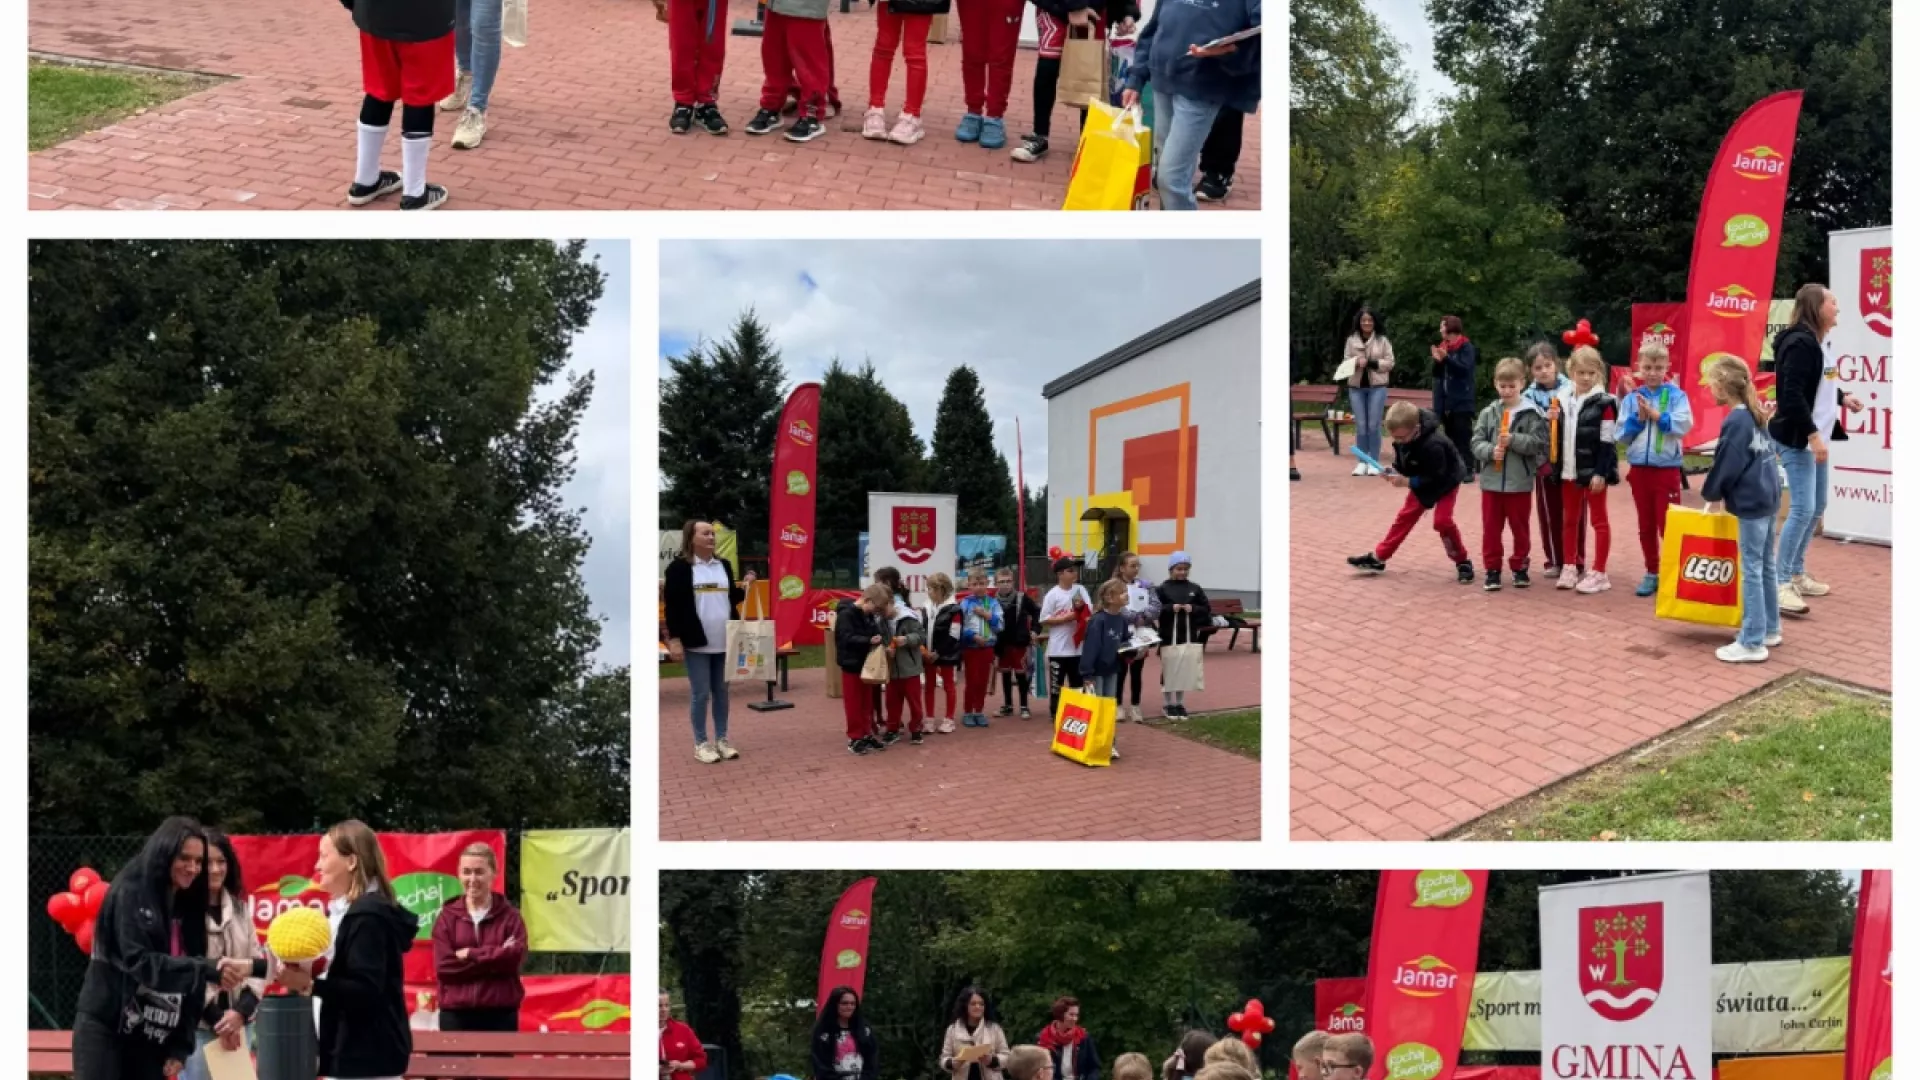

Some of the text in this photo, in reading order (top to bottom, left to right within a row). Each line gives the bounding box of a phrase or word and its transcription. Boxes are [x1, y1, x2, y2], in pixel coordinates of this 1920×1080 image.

[1732, 154, 1785, 176] Jamar
[1705, 291, 1758, 311] Jamar
[1684, 556, 1735, 583] LEGO
[1062, 718, 1088, 736] LEGO
[1392, 967, 1458, 989] Jamar
[1328, 1015, 1365, 1031] Jama
[1551, 1044, 1697, 1080] GMINA
